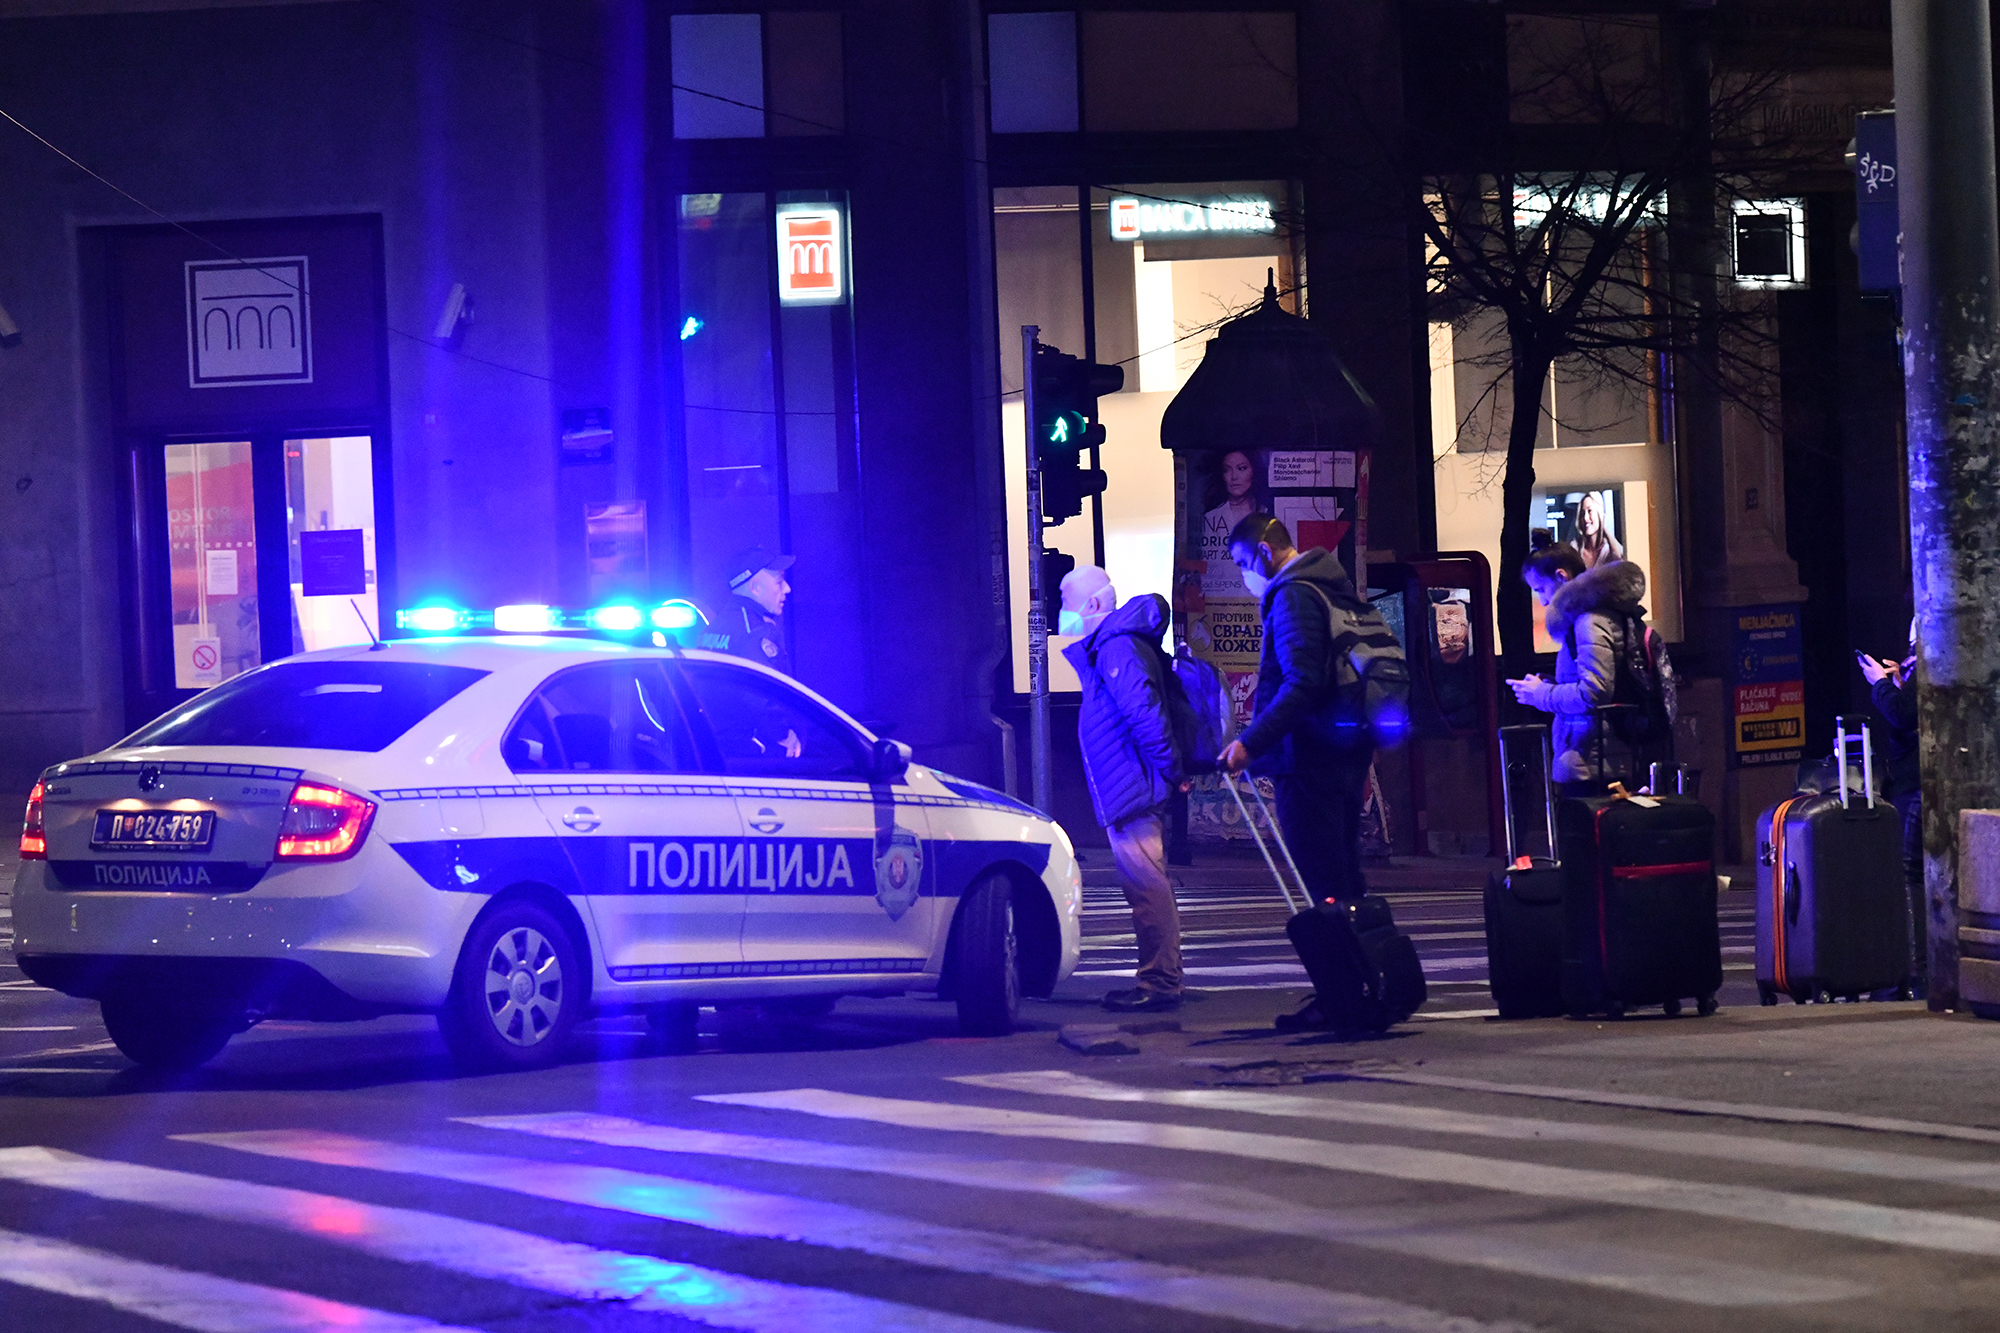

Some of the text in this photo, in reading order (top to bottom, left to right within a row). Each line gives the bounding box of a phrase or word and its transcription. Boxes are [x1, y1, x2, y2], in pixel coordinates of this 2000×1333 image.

[1212, 612, 1254, 623] ПРОТИВ
[1213, 638, 1260, 652] КОЖЕ
[134, 815, 203, 840] 024-759
[94, 864, 212, 887] ПОЛИЦИЈА
[629, 842, 855, 892] ПОЛИЦИЈА
